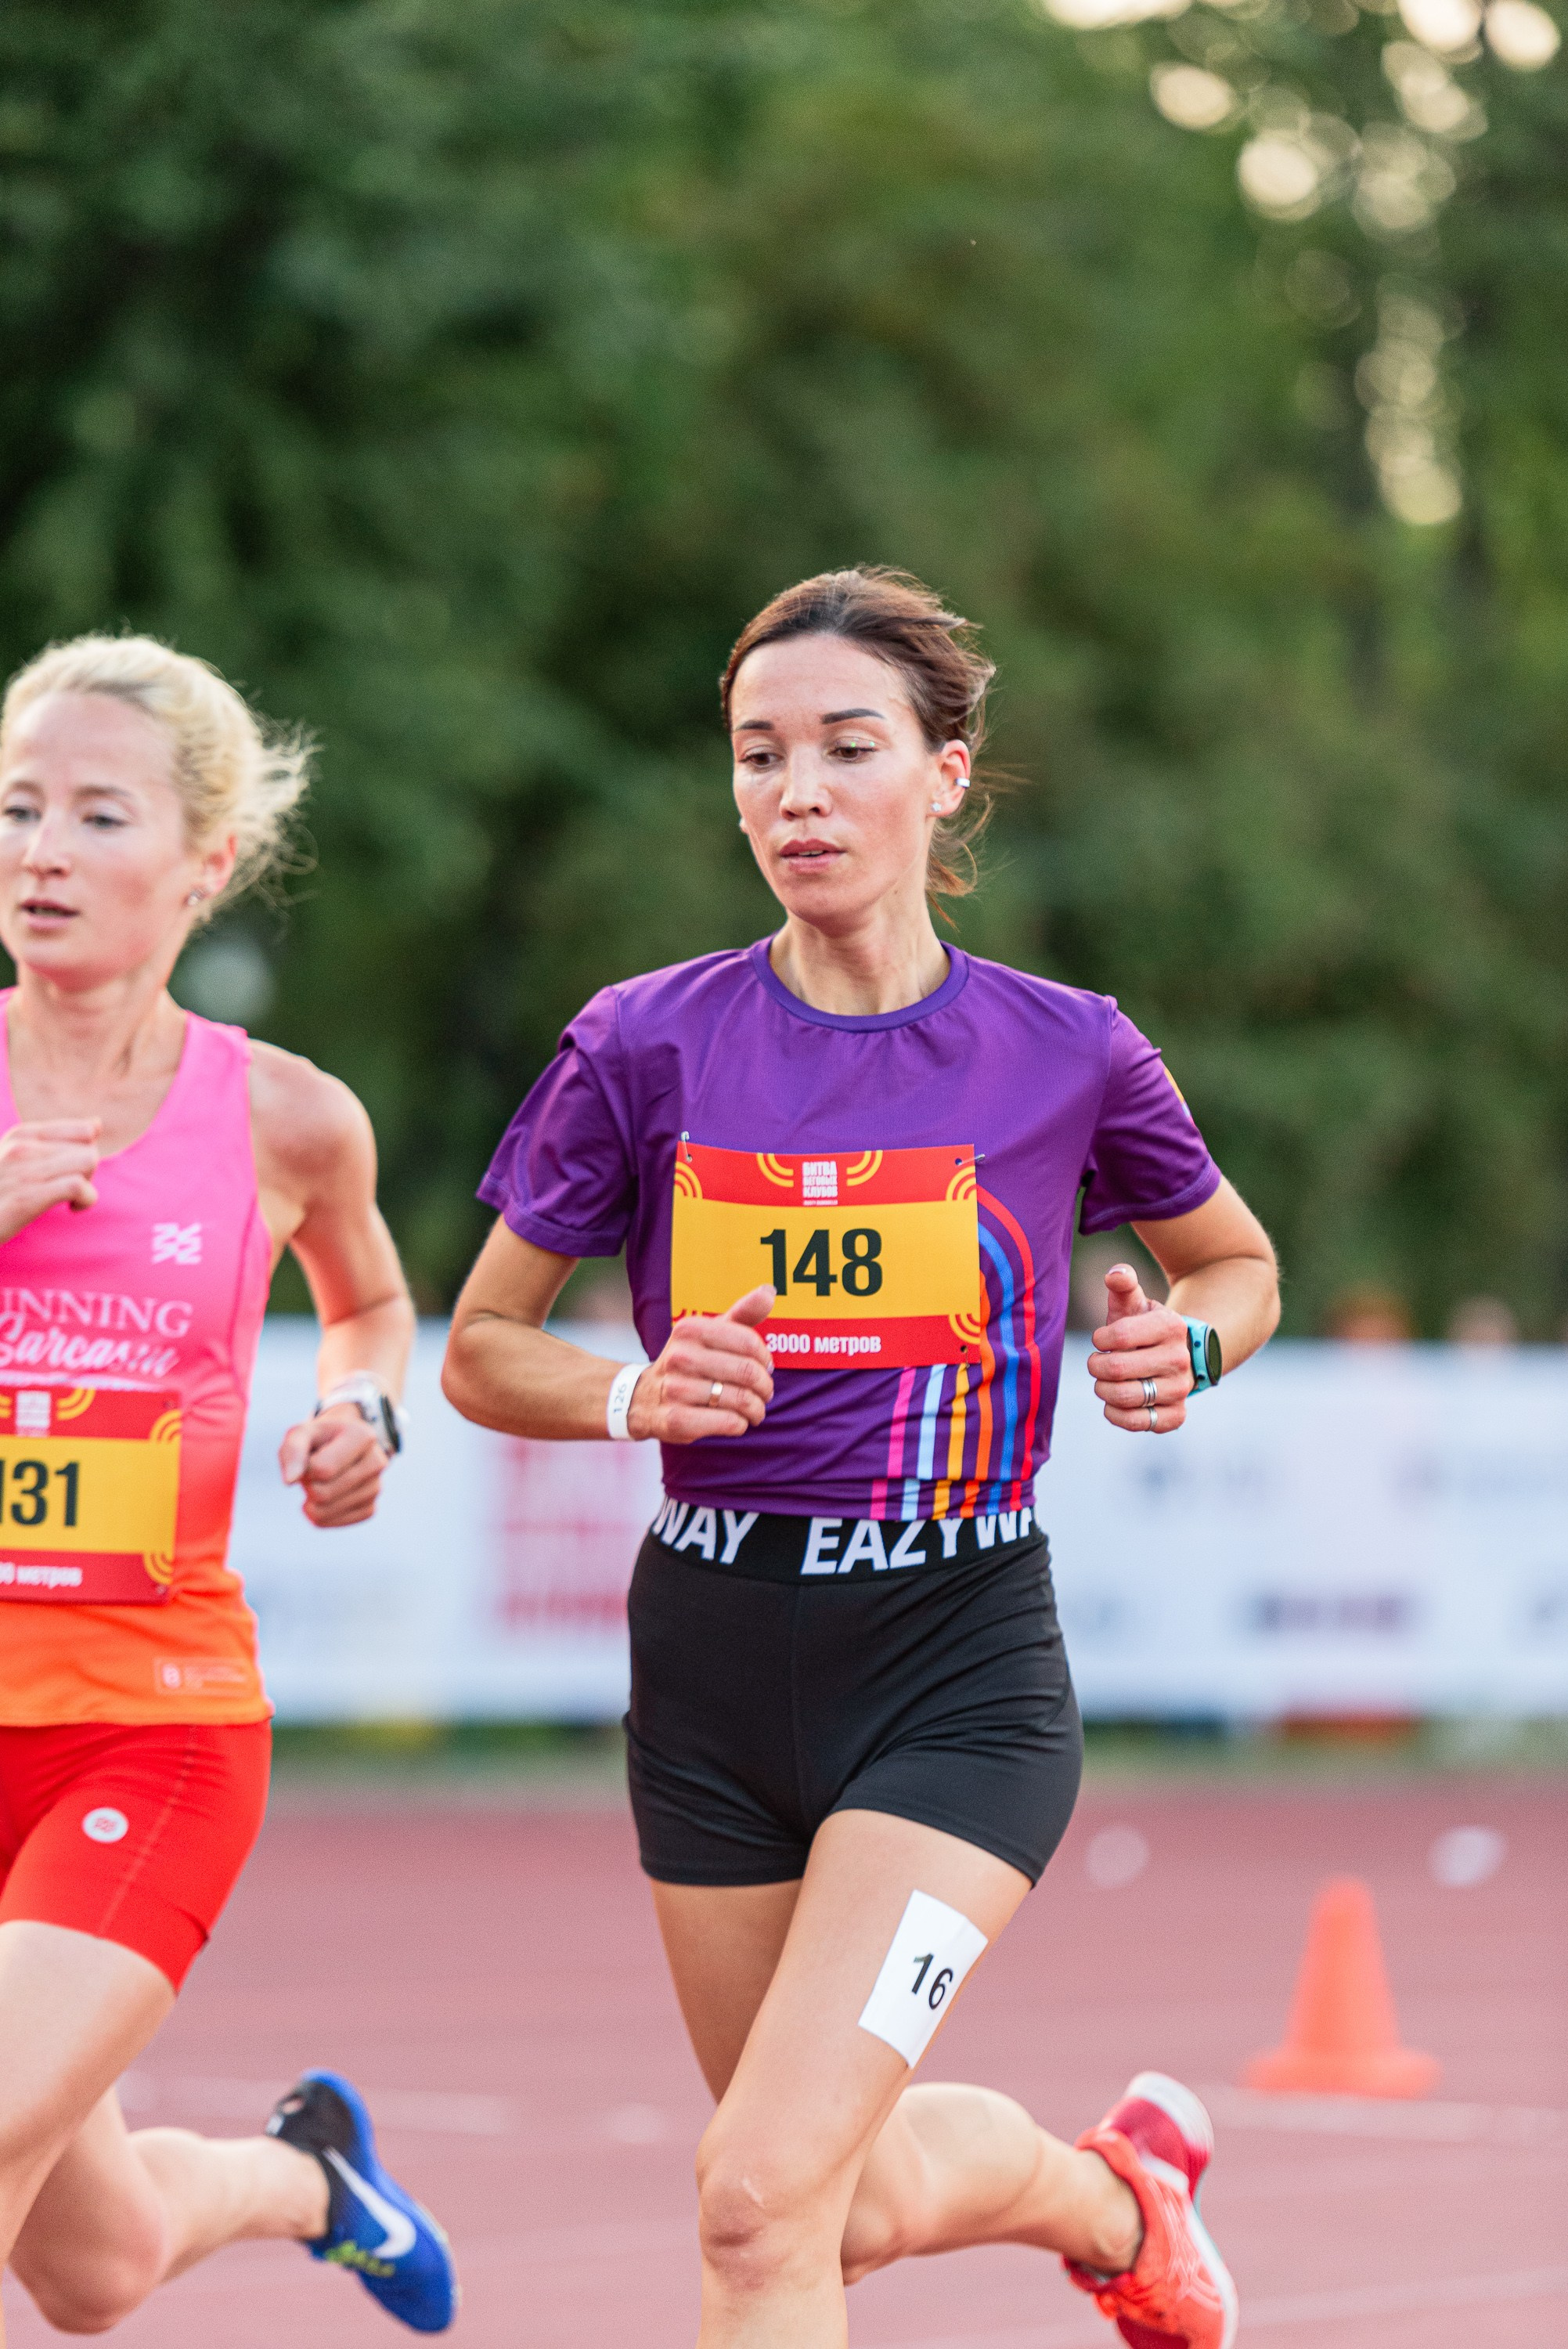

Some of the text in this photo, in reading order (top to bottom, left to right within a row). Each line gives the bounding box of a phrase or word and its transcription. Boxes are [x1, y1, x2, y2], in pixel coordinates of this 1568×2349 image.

[802, 1161, 837, 1175] БИТВА
[760, 1228, 883, 1297] 148
[766, 1333, 881, 1356] 3000 метров
[613, 1383, 627, 1414] 126
[911, 1953, 953, 2010] 16
